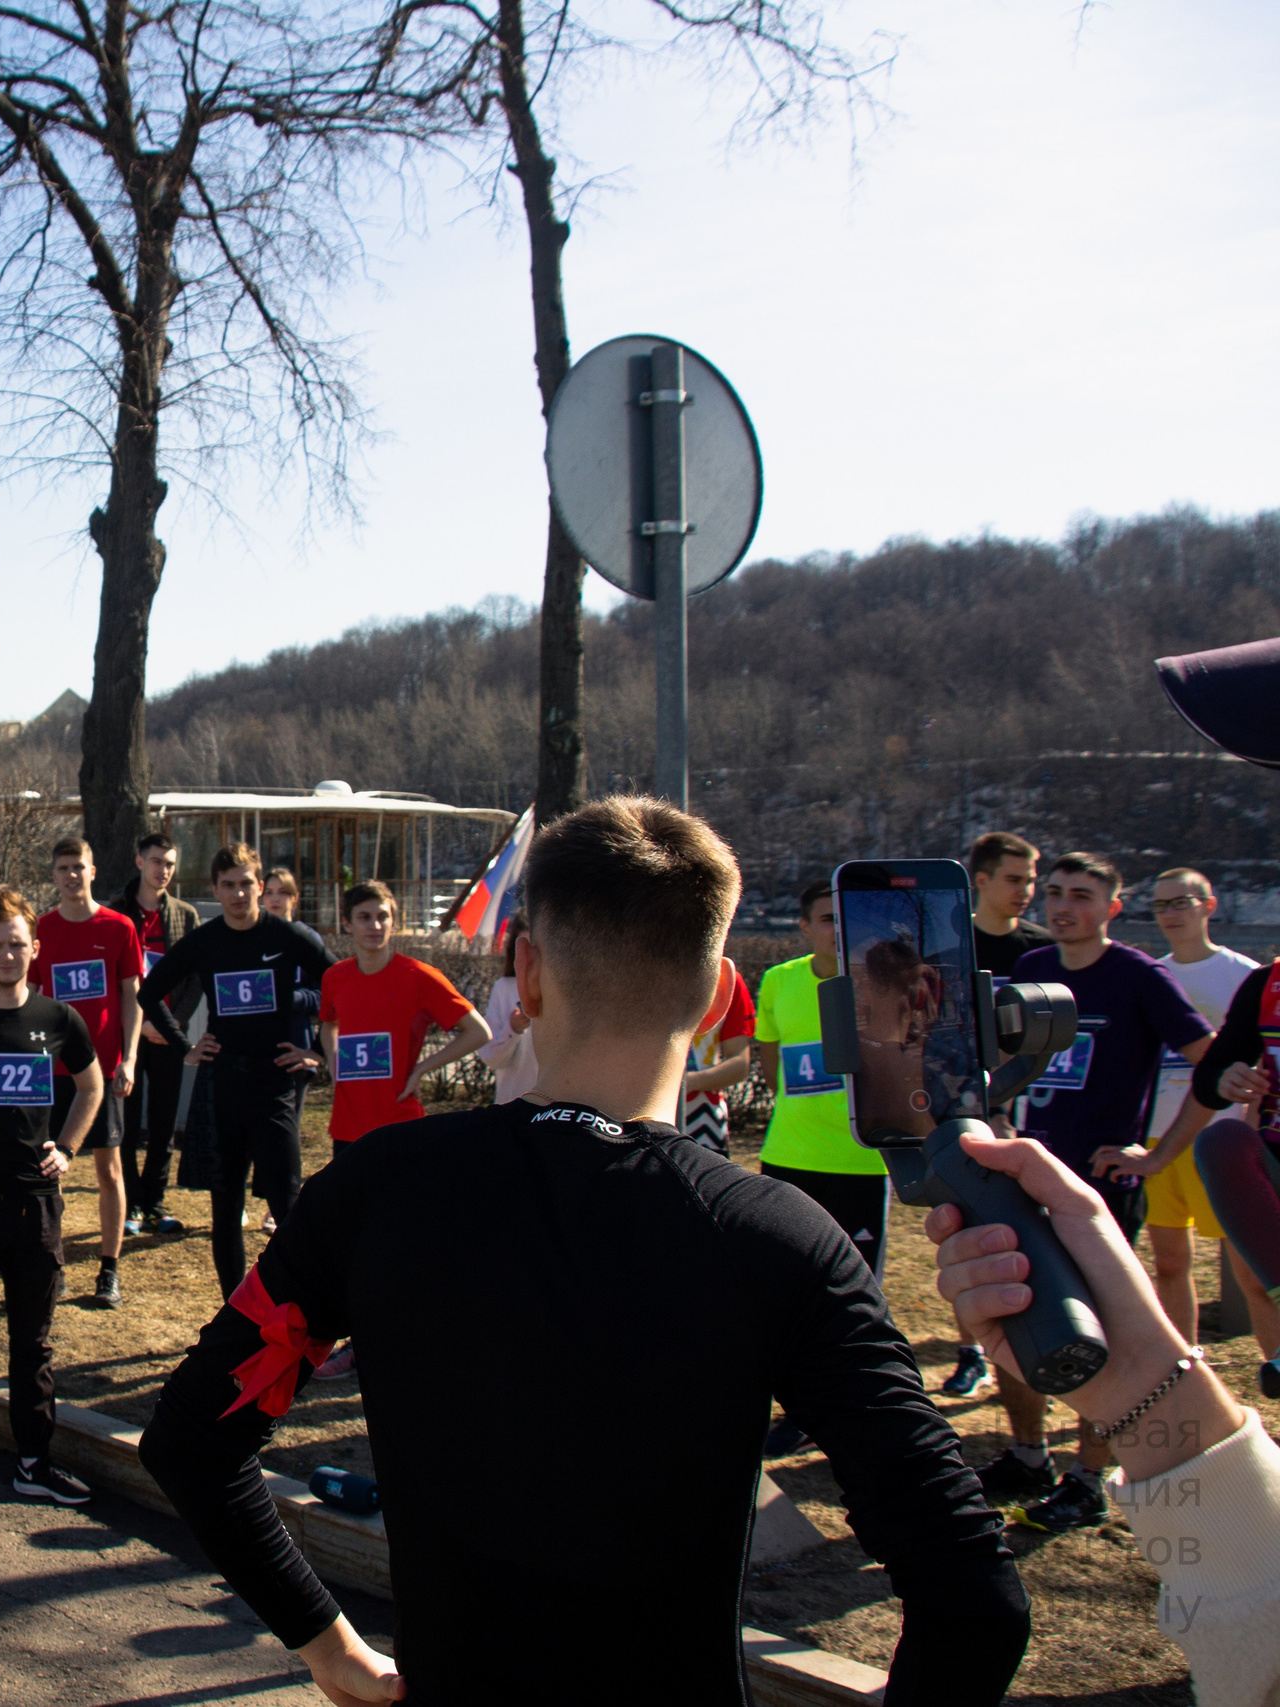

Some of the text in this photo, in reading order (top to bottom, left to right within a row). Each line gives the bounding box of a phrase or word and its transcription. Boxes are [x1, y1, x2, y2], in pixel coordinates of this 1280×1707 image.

[67, 968, 90, 991] 18
[238, 979, 253, 1003] 6
[355, 1042, 369, 1068] 5
[798, 1053, 816, 1081] 4
[0, 1064, 33, 1092] 22
[530, 1108, 623, 1136] NIKE PRO
